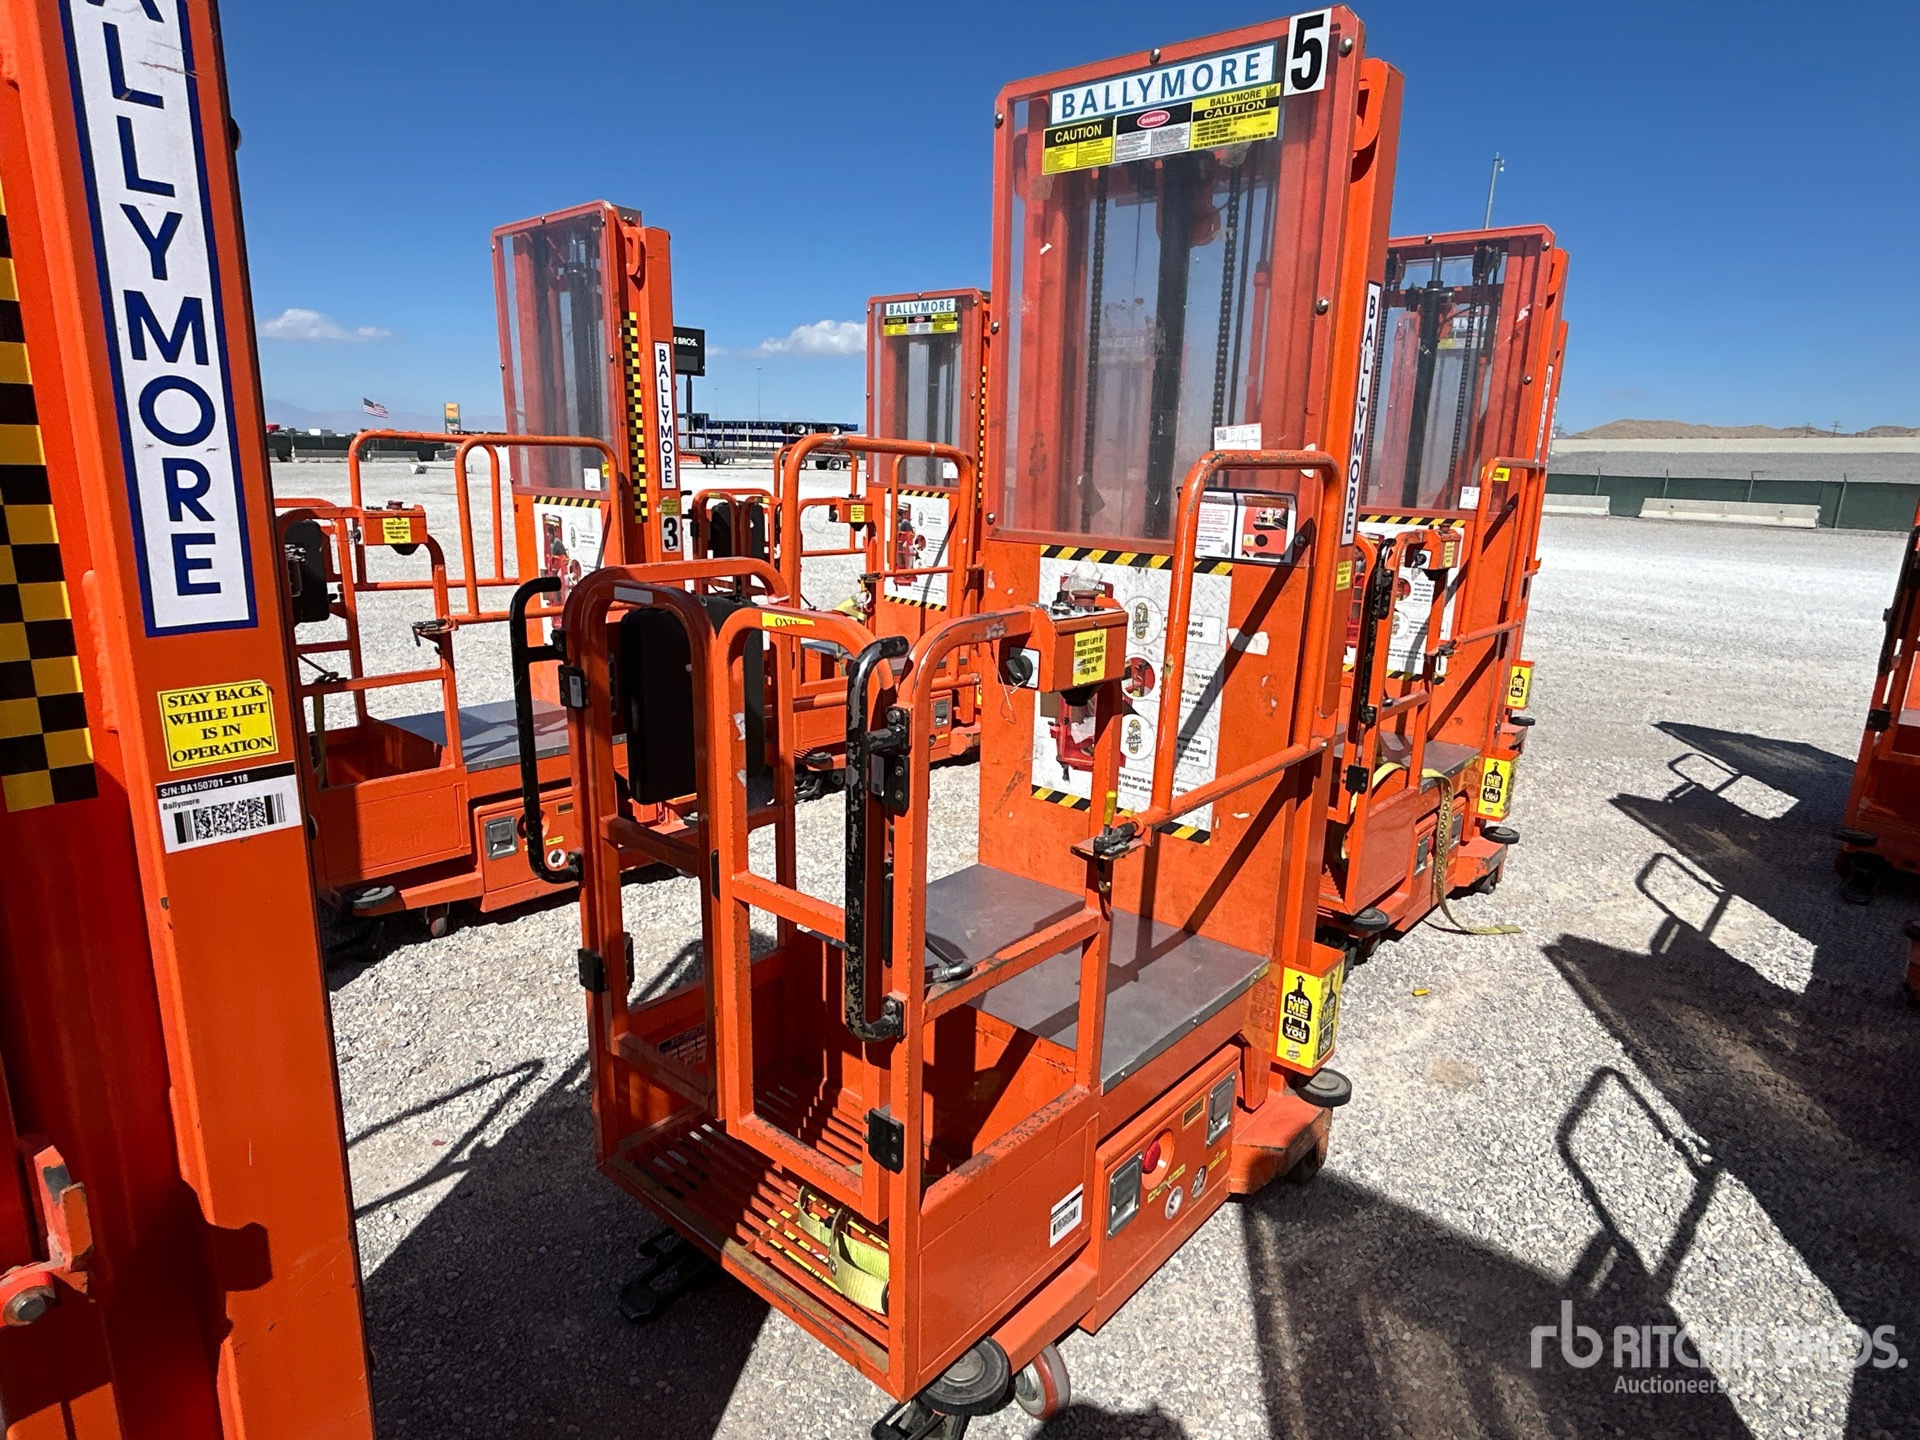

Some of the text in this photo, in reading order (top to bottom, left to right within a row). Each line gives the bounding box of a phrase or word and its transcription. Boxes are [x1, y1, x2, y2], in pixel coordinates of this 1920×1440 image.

[1290, 13, 1325, 91] 5
[1061, 52, 1261, 119] BALLYMORE
[1210, 89, 1261, 107] BALLYMORE
[1204, 99, 1267, 119] CAUTION
[1055, 124, 1102, 143] CAUTION
[889, 300, 951, 315] BALLYMORE
[658, 348, 672, 484] BALLYMORE
[1345, 295, 1376, 535] BALLYMORE
[663, 517, 678, 551] 3
[168, 684, 264, 709] STAY BACK
[168, 702, 267, 726] WHILE LIFT
[201, 723, 241, 740] IS IN
[173, 736, 273, 762] OPERATION
[163, 798, 200, 811] Ballymore
[1485, 793, 1498, 801] YOU
[1288, 994, 1309, 1006] PLUG
[1288, 1001, 1308, 1016] ME
[1286, 1026, 1306, 1040] YOU
